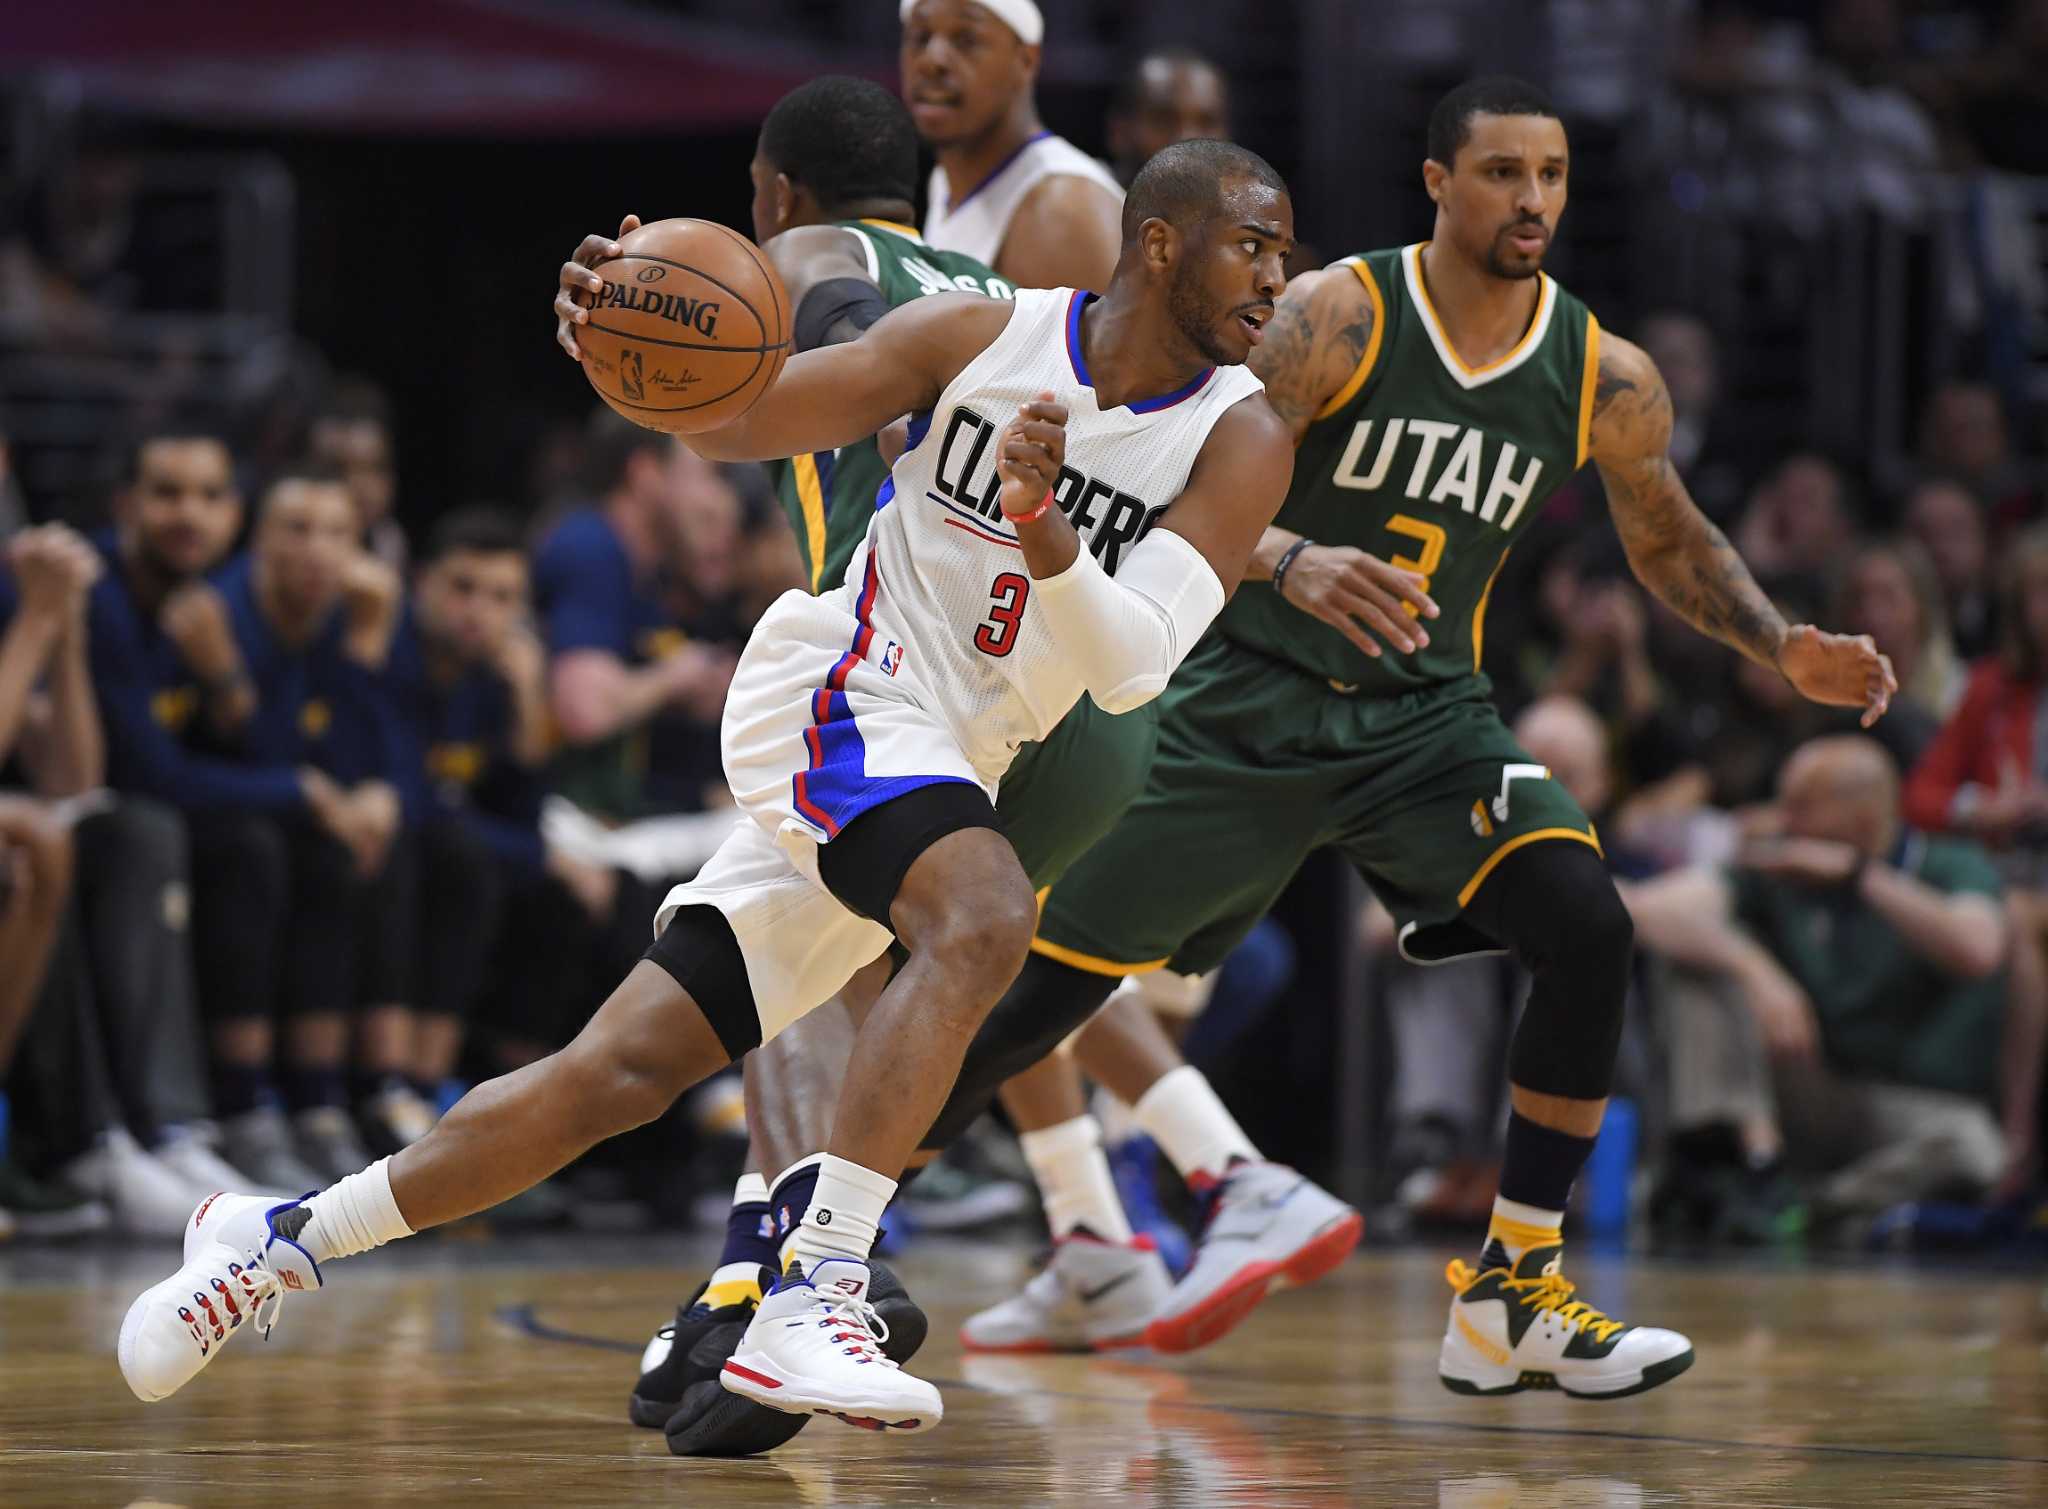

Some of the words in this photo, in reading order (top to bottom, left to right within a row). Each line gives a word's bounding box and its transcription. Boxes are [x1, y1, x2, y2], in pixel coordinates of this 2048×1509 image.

[935, 406, 1169, 578] CLIPER
[1332, 417, 1544, 532] UTAH
[973, 572, 1030, 657] 3
